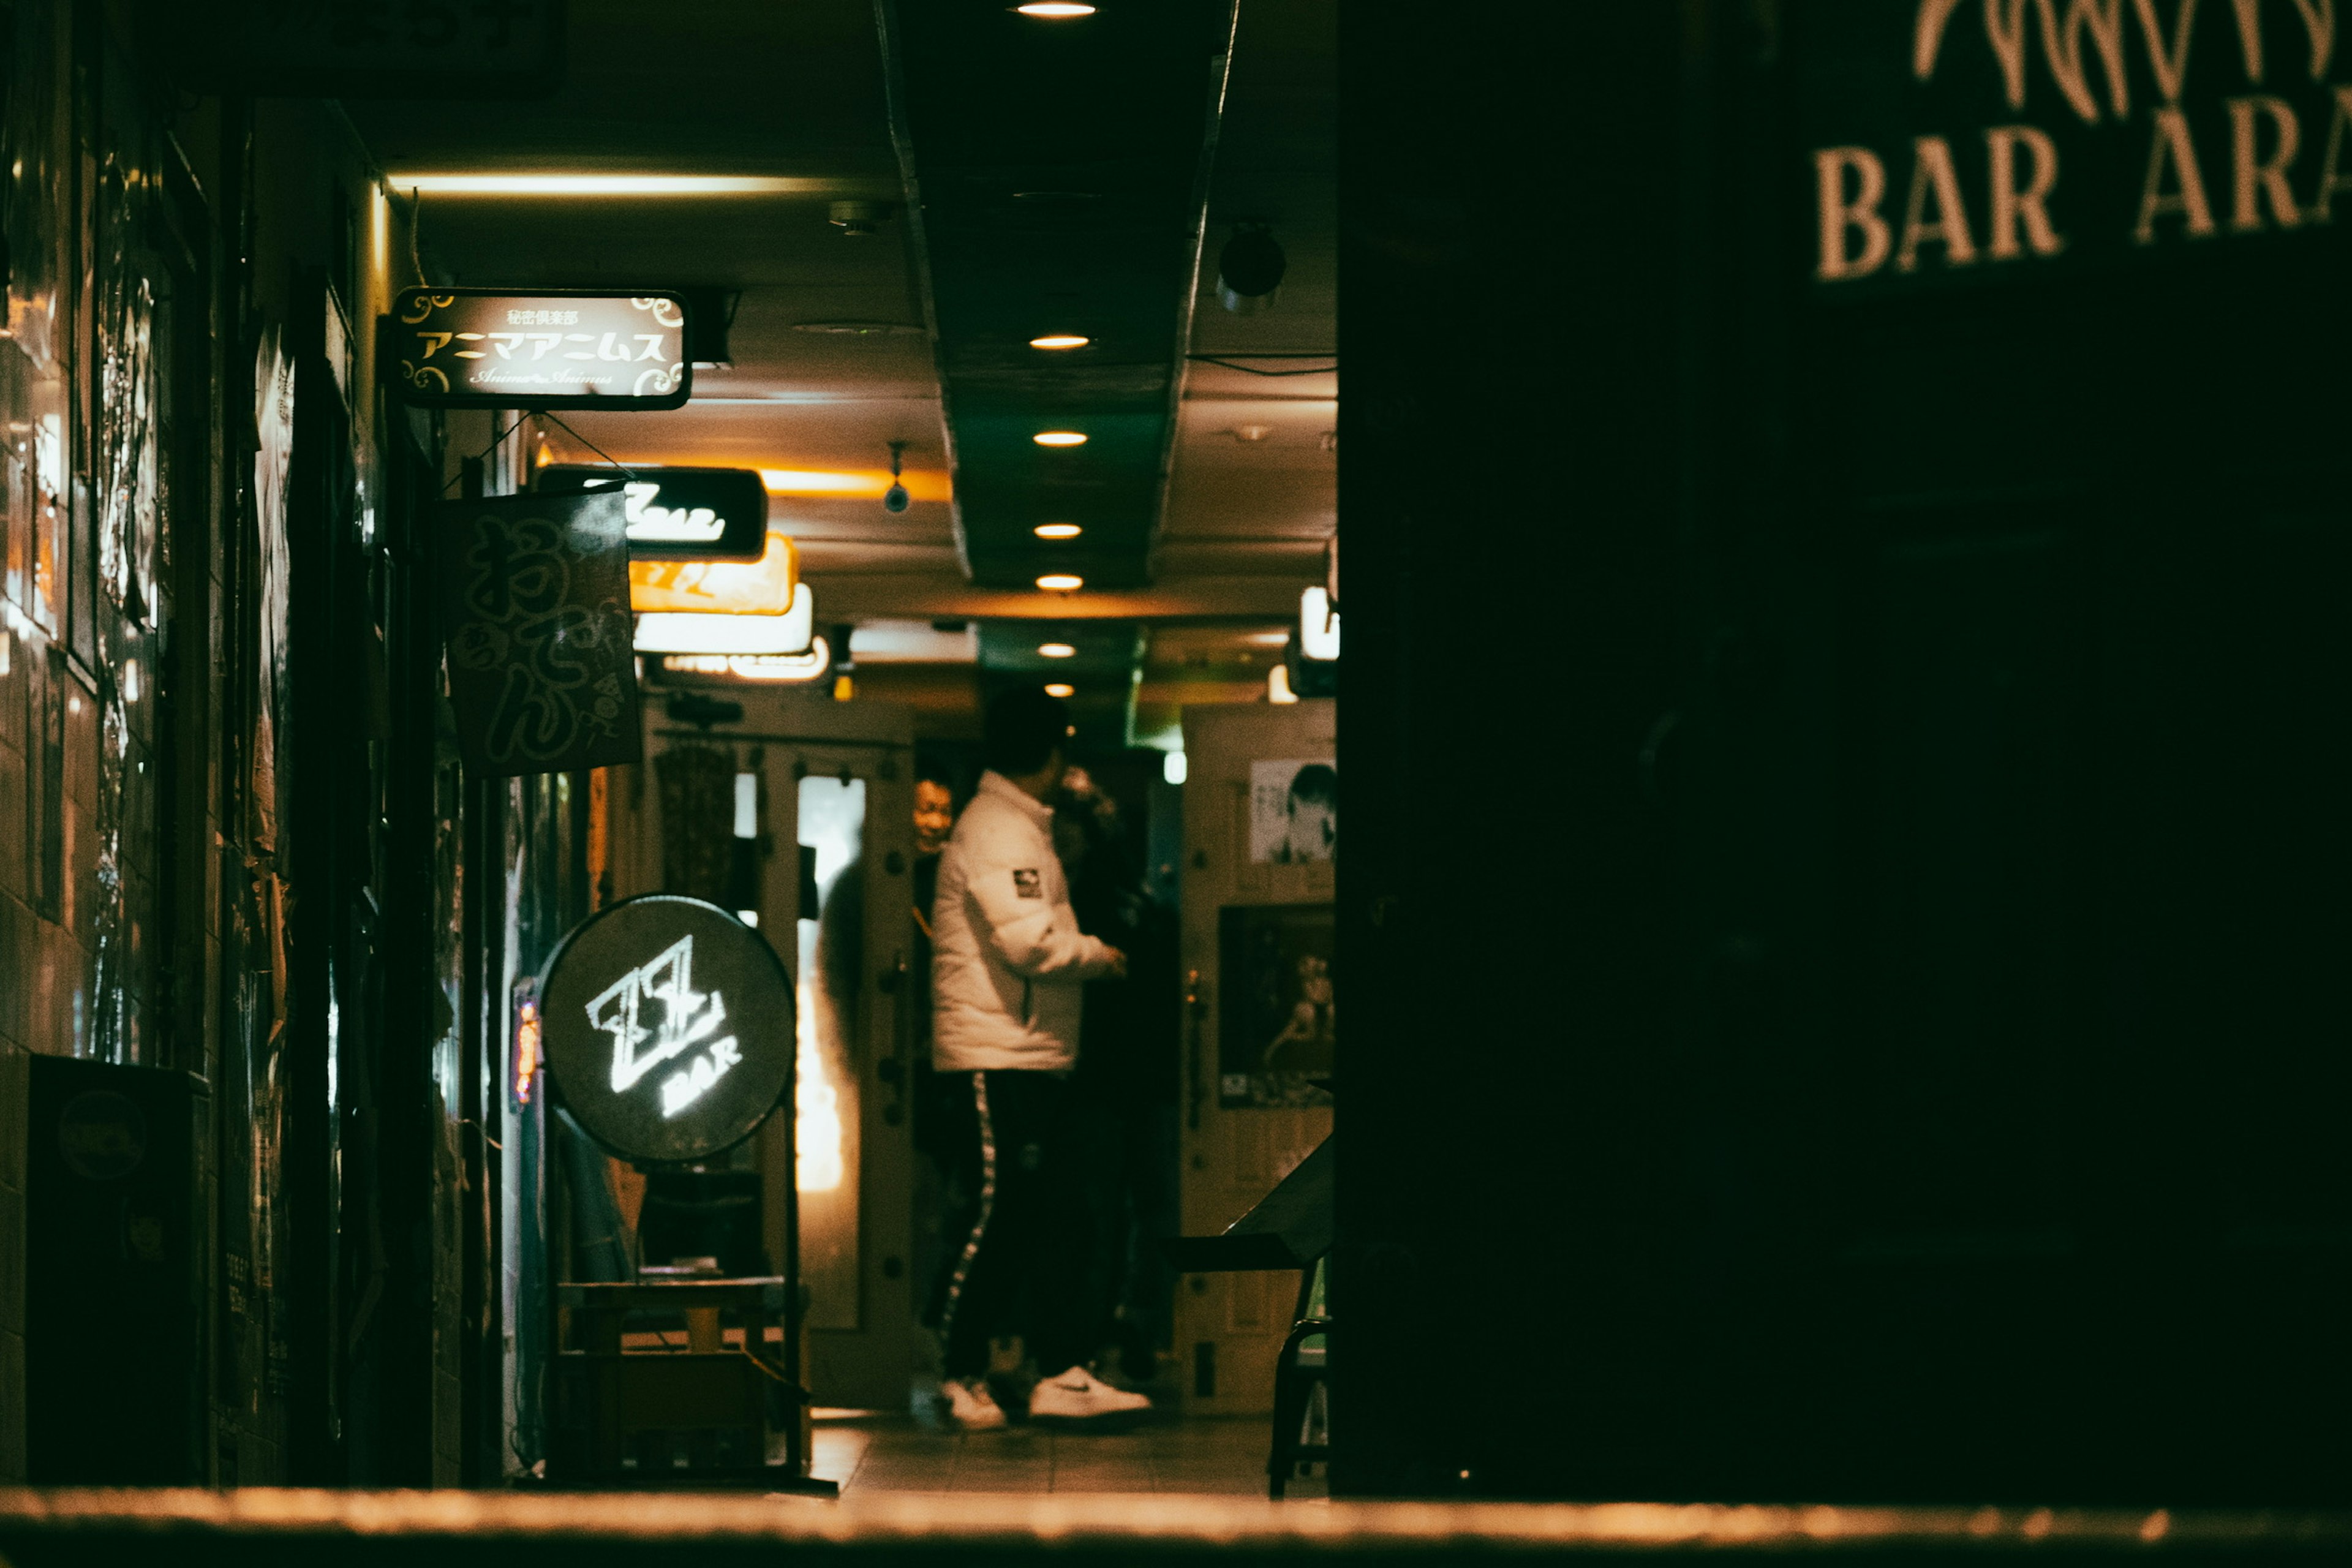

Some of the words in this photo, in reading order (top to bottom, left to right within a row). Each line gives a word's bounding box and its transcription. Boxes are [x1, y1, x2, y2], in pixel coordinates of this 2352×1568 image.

[1811, 124, 2068, 284] BAR
[416, 331, 668, 363] アニマアニムス
[466, 514, 600, 763] おでん
[662, 1035, 743, 1117] BAR
